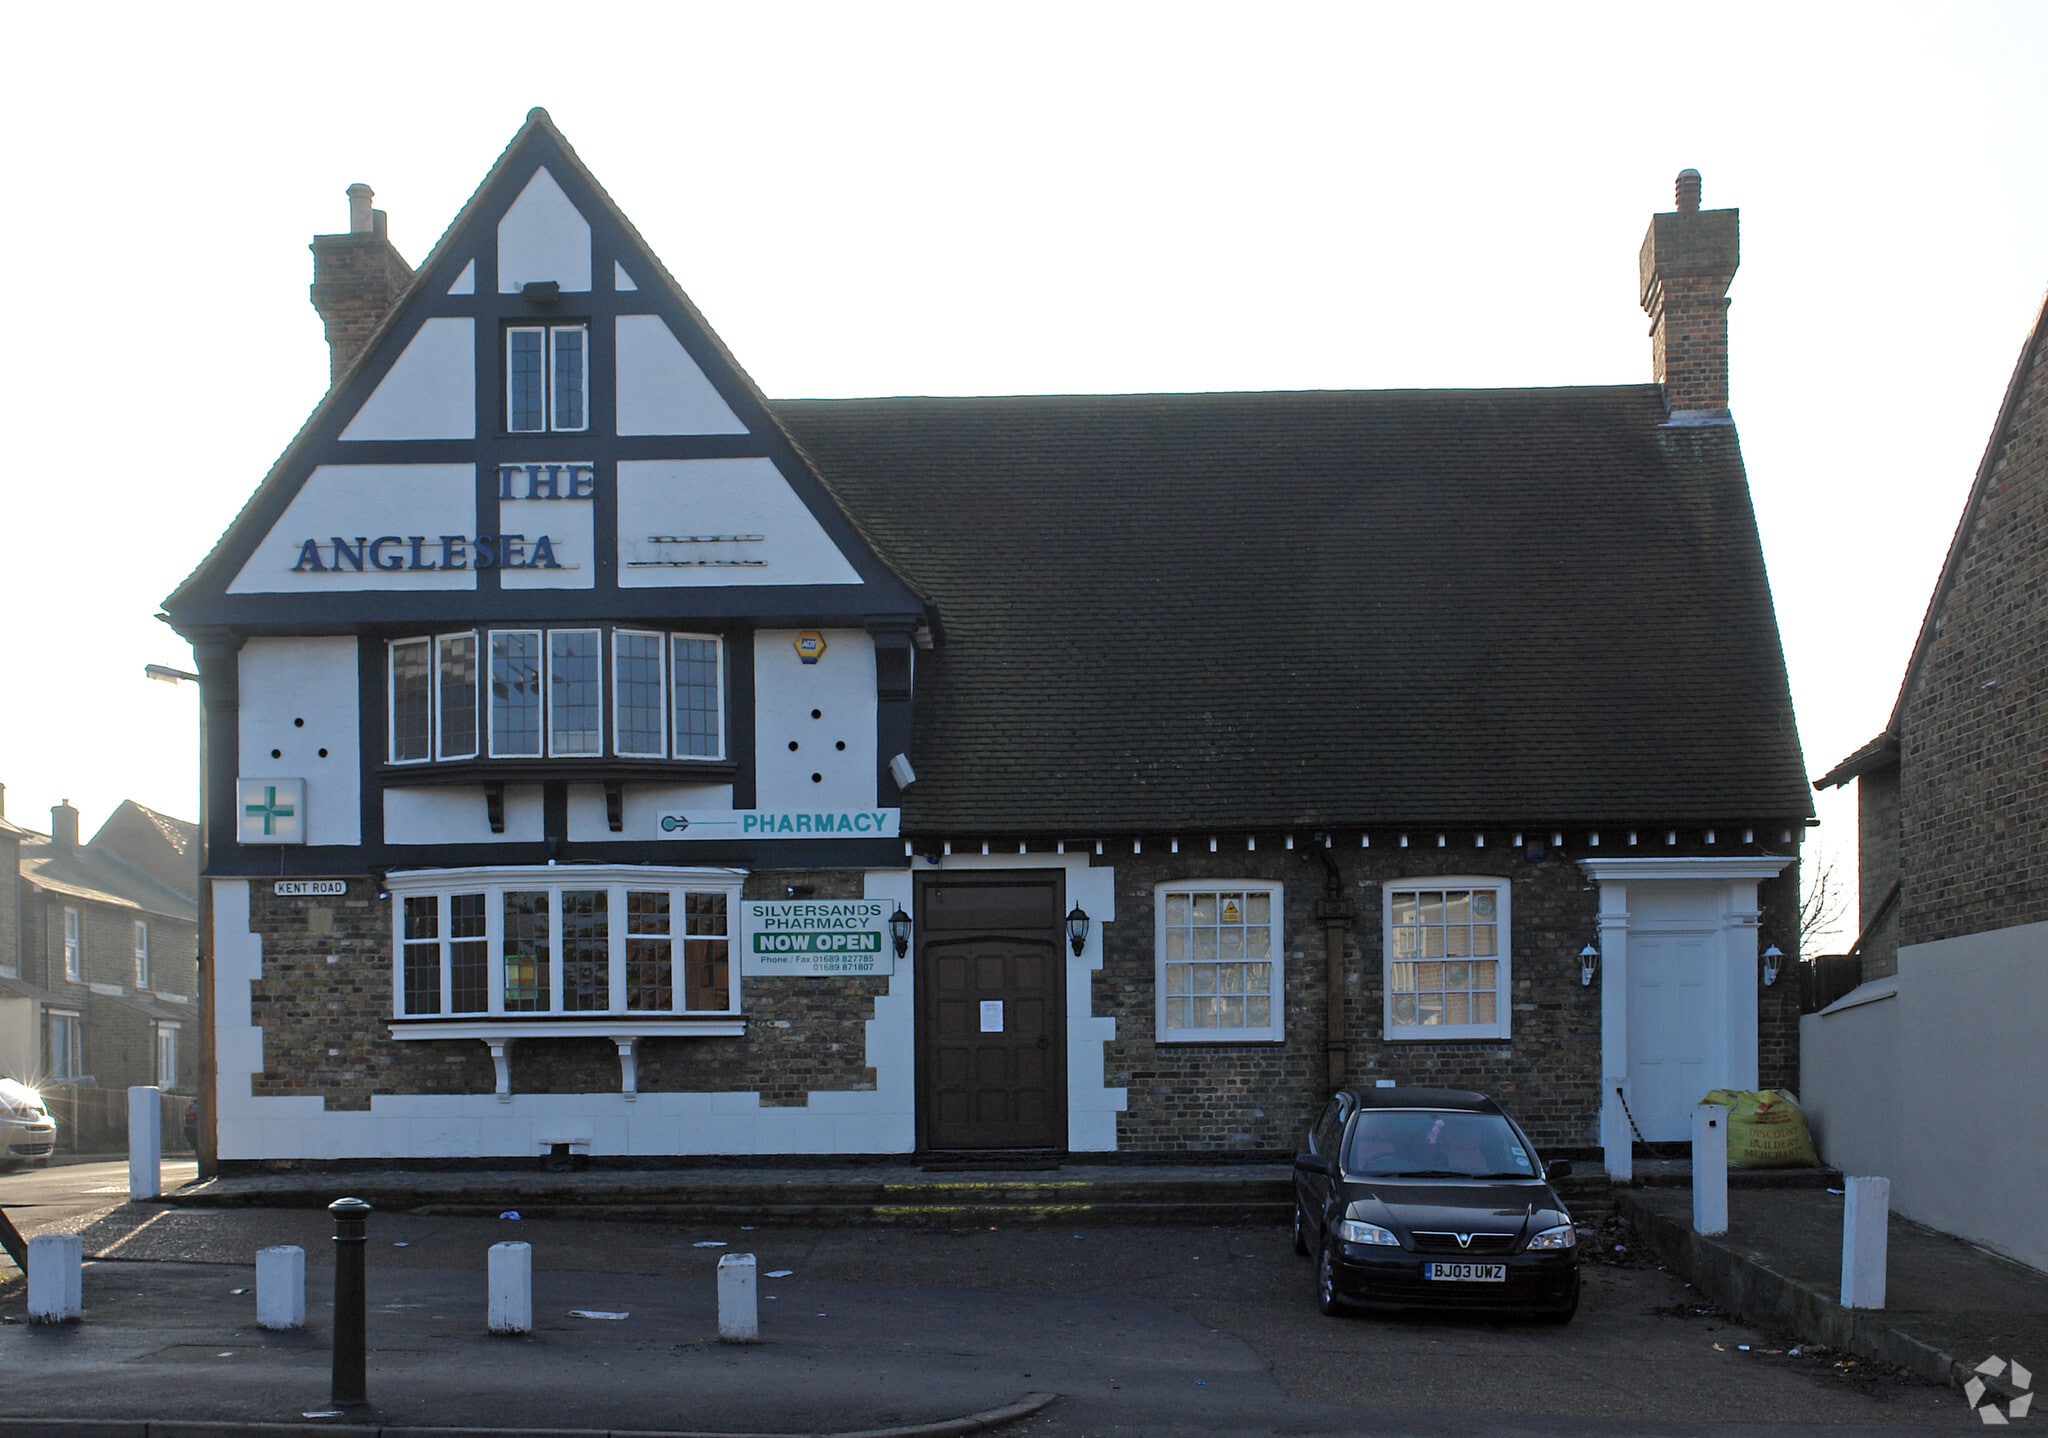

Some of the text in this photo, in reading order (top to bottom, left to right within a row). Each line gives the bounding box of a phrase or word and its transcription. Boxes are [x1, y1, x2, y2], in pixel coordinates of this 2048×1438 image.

[496, 464, 594, 500] THE
[291, 534, 562, 572] ANGLESEA
[743, 813, 887, 833] PHARMACY
[278, 882, 342, 893] KENT ROAD
[753, 905, 882, 917] SILVERSANDS
[765, 918, 870, 929] PHARMACY
[760, 934, 875, 950] NOW OPEN
[813, 955, 840, 963] 01689
[813, 963, 840, 971] 01689
[1749, 1126, 1798, 1138] DISCOUNT
[1434, 1264, 1503, 1279] BJ03 UWZ
